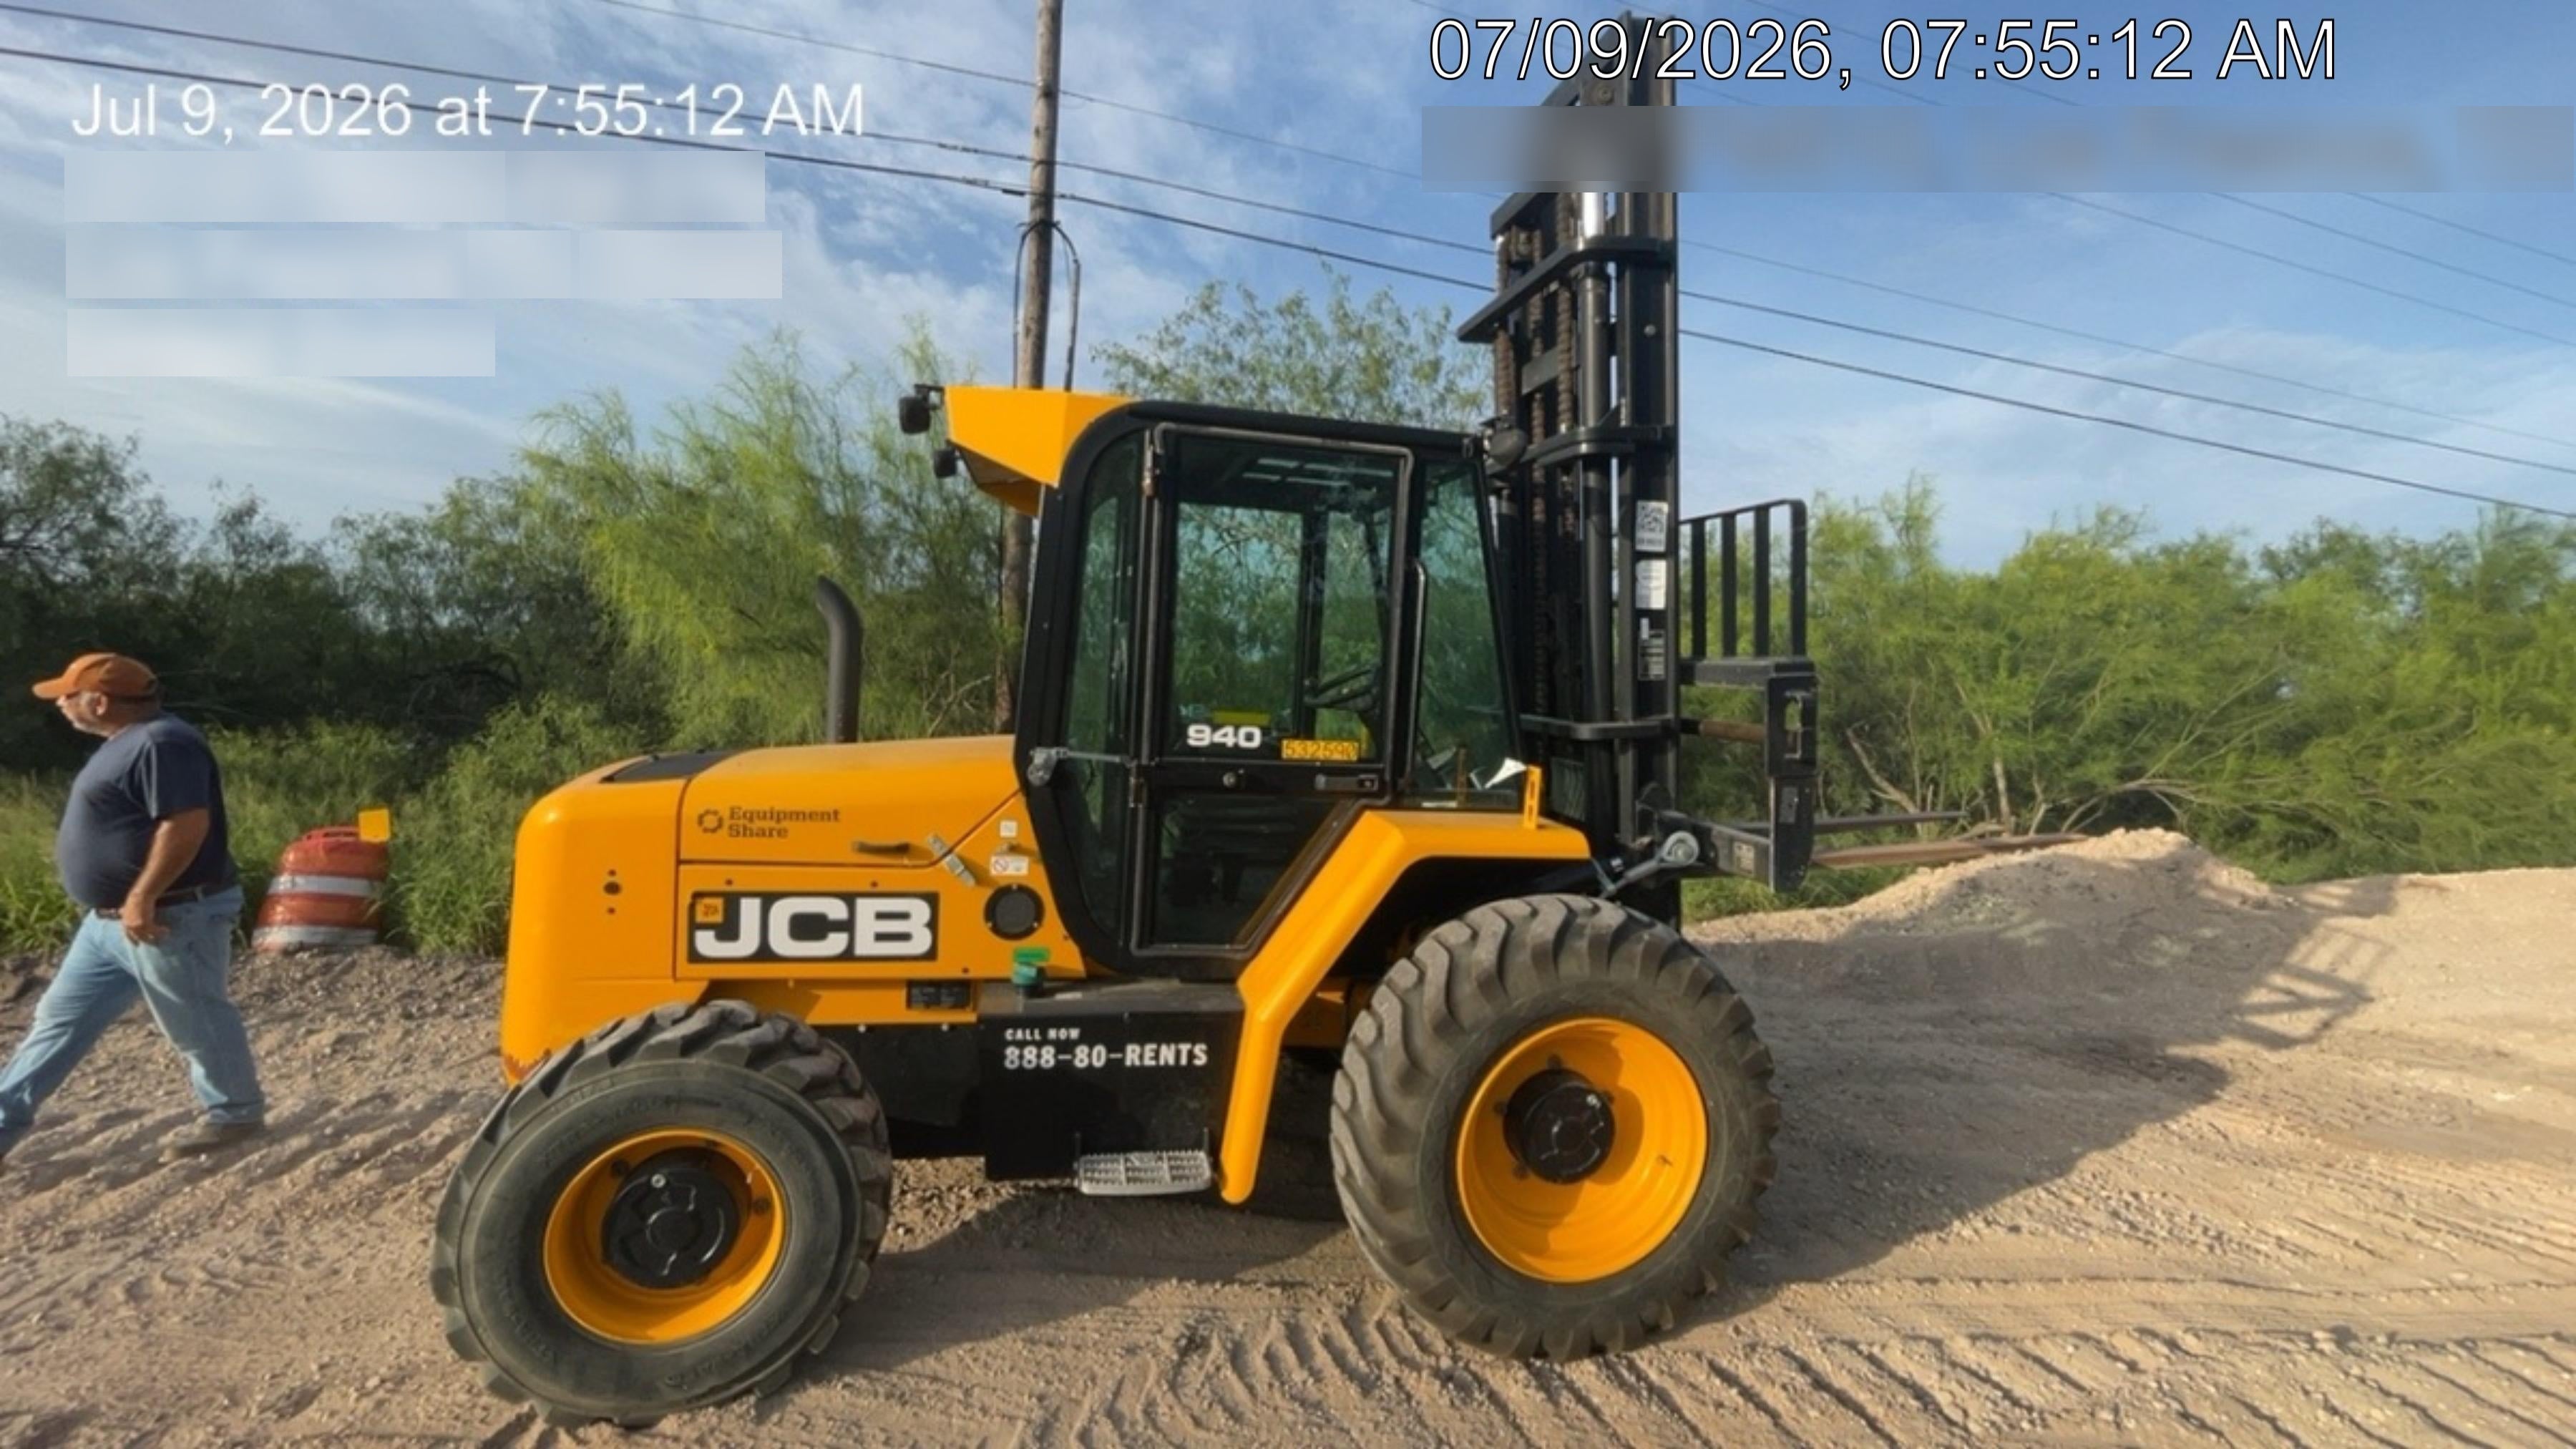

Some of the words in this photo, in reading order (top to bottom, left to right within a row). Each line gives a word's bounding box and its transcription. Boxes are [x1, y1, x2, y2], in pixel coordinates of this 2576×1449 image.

[1186, 724, 1262, 748] 940
[728, 806, 840, 823] Equipment
[728, 824, 788, 838] Share
[694, 897, 932, 957] JCB
[1004, 1028, 1043, 1040] CALL
[1047, 1028, 1080, 1040] NOW
[1004, 1043, 1208, 1070] 888-80-RENTS
